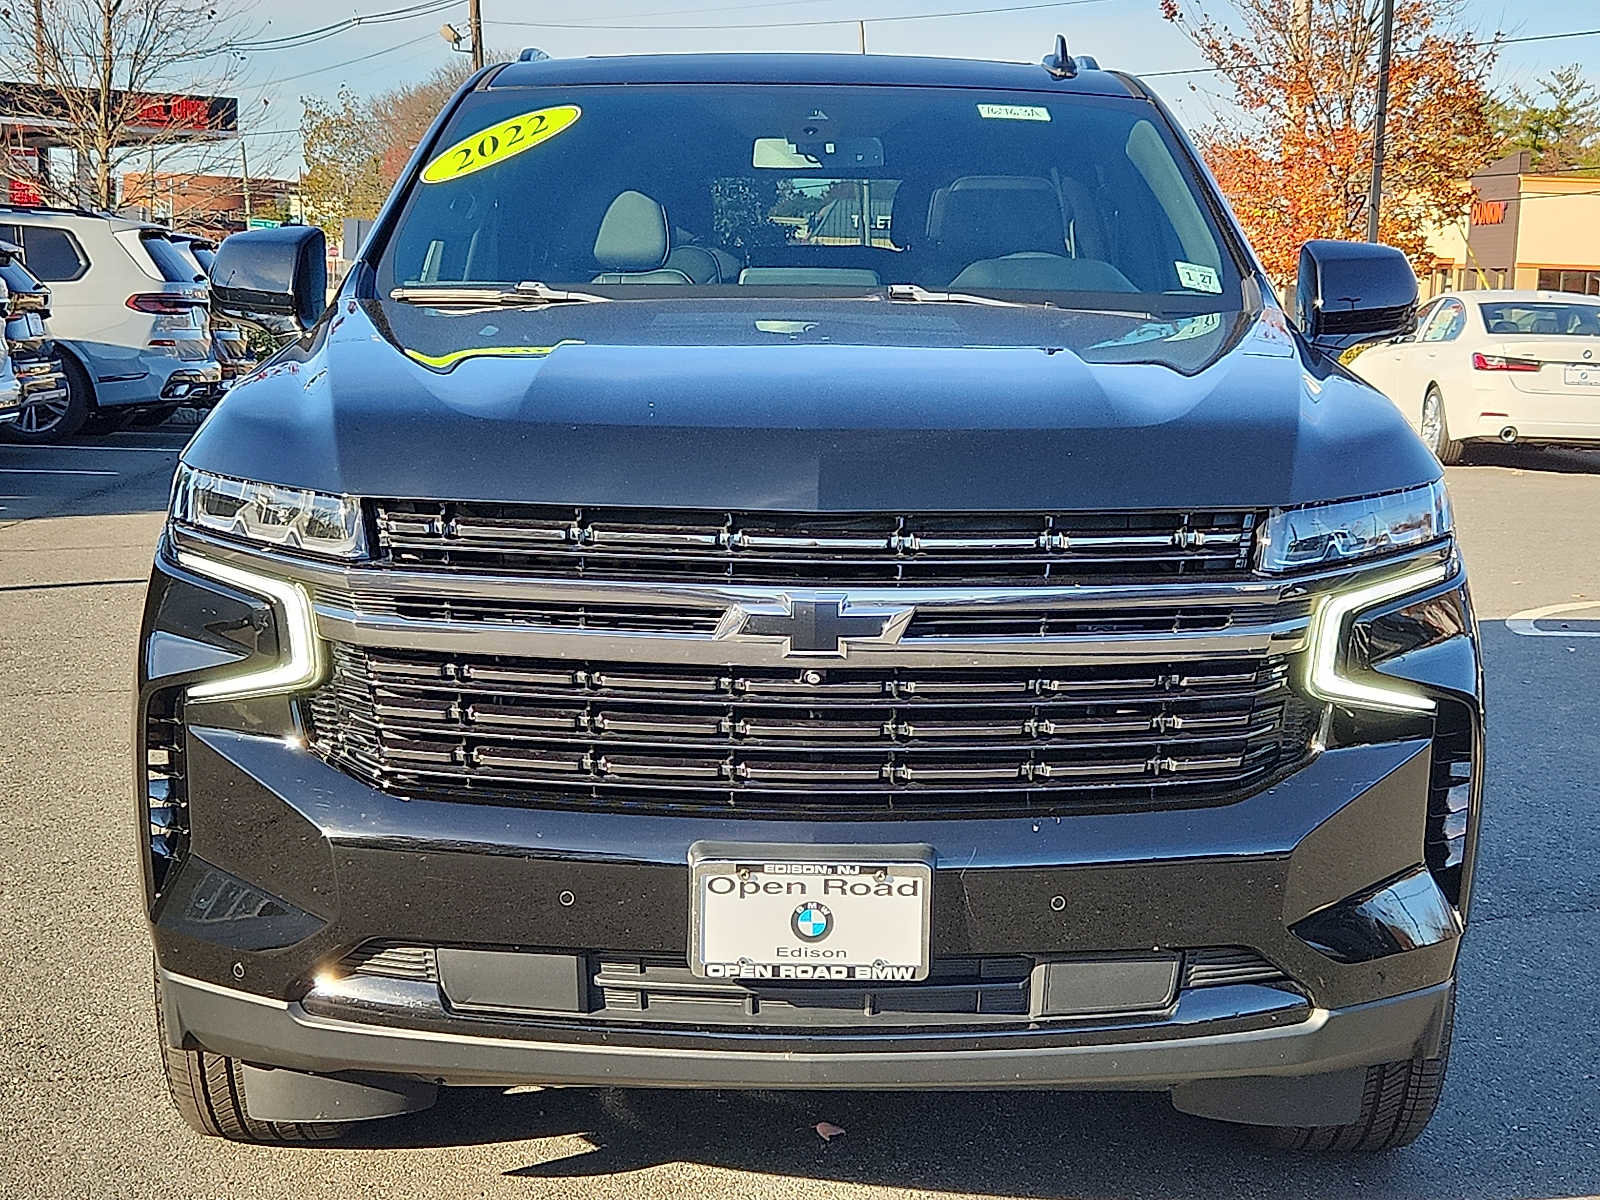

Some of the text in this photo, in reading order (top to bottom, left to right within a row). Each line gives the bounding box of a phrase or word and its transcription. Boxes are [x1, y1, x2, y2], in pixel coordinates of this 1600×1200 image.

[453, 115, 549, 172] 2022
[1185, 271, 1195, 282] 1
[1199, 273, 1212, 285] 27
[763, 864, 861, 876] EDISON, NJ
[707, 876, 919, 899] Open Road
[795, 902, 831, 916] BMW
[776, 946, 848, 959] Edison
[705, 963, 916, 981] OPEN ROAD BMW
